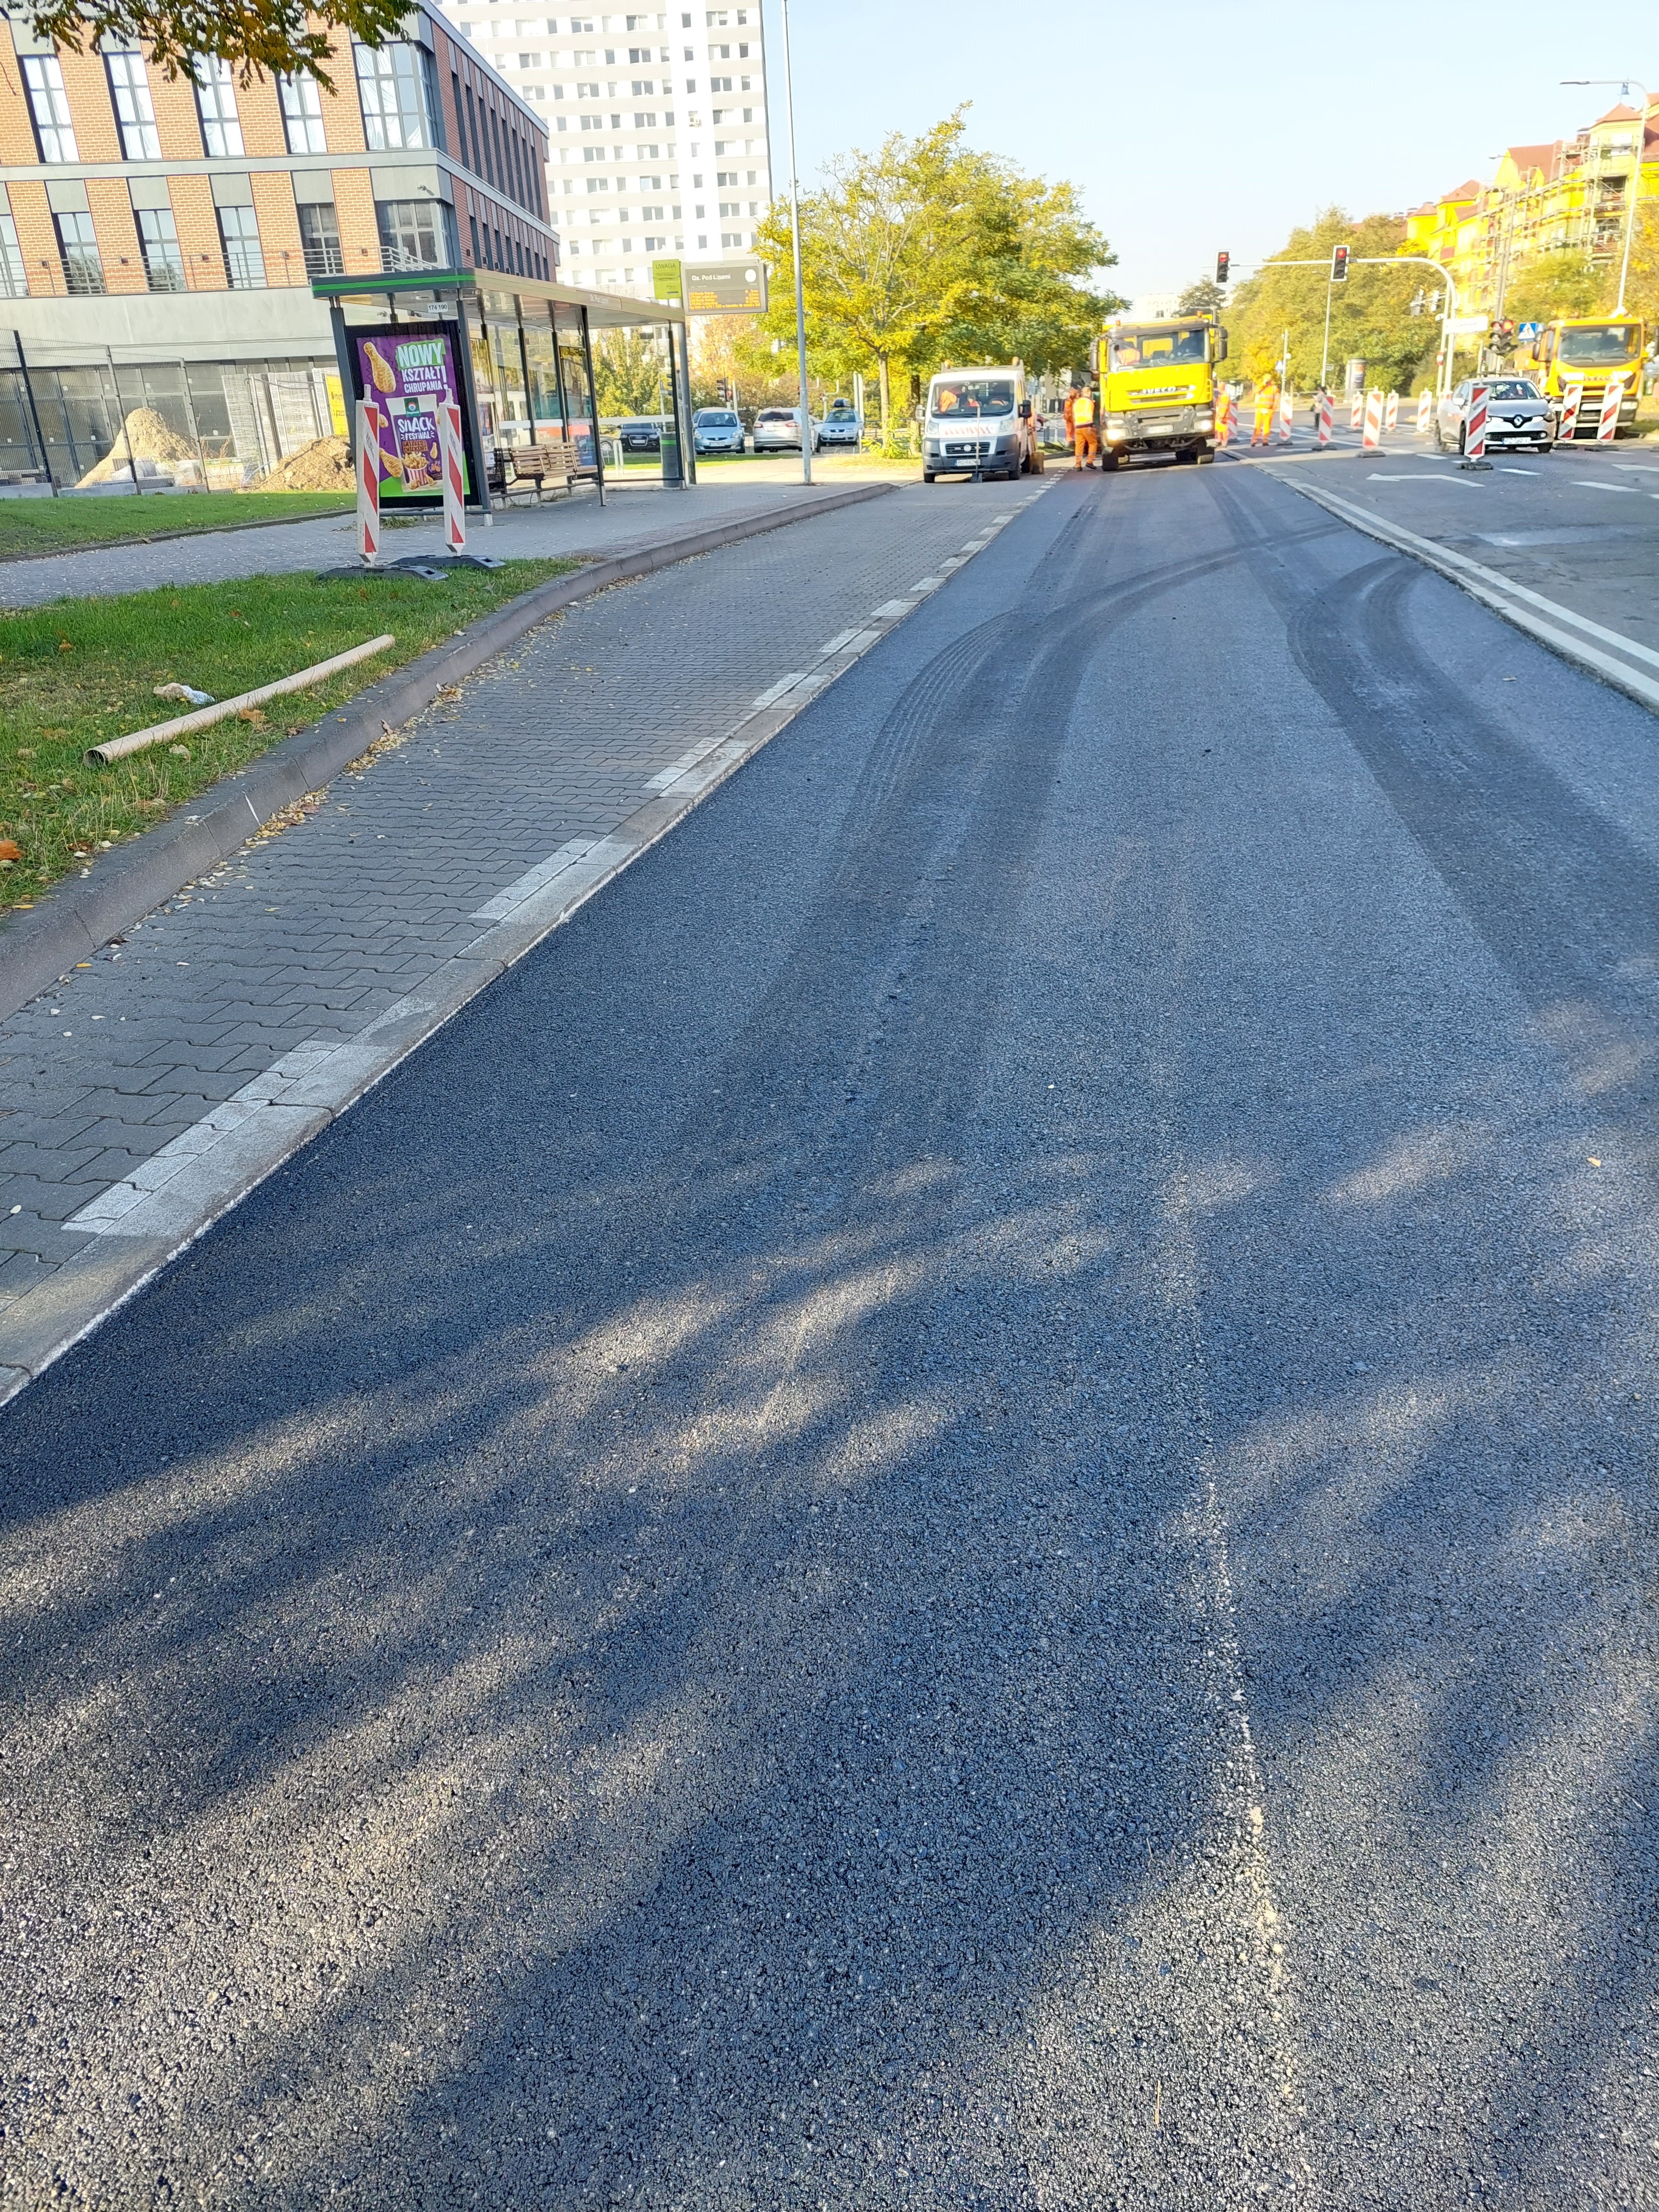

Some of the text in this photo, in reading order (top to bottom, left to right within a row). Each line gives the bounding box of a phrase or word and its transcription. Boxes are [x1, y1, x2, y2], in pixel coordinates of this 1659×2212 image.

[397, 342, 442, 367] NOWY
[404, 380, 442, 393] CHRUPANIA
[1142, 386, 1177, 394] IVECO
